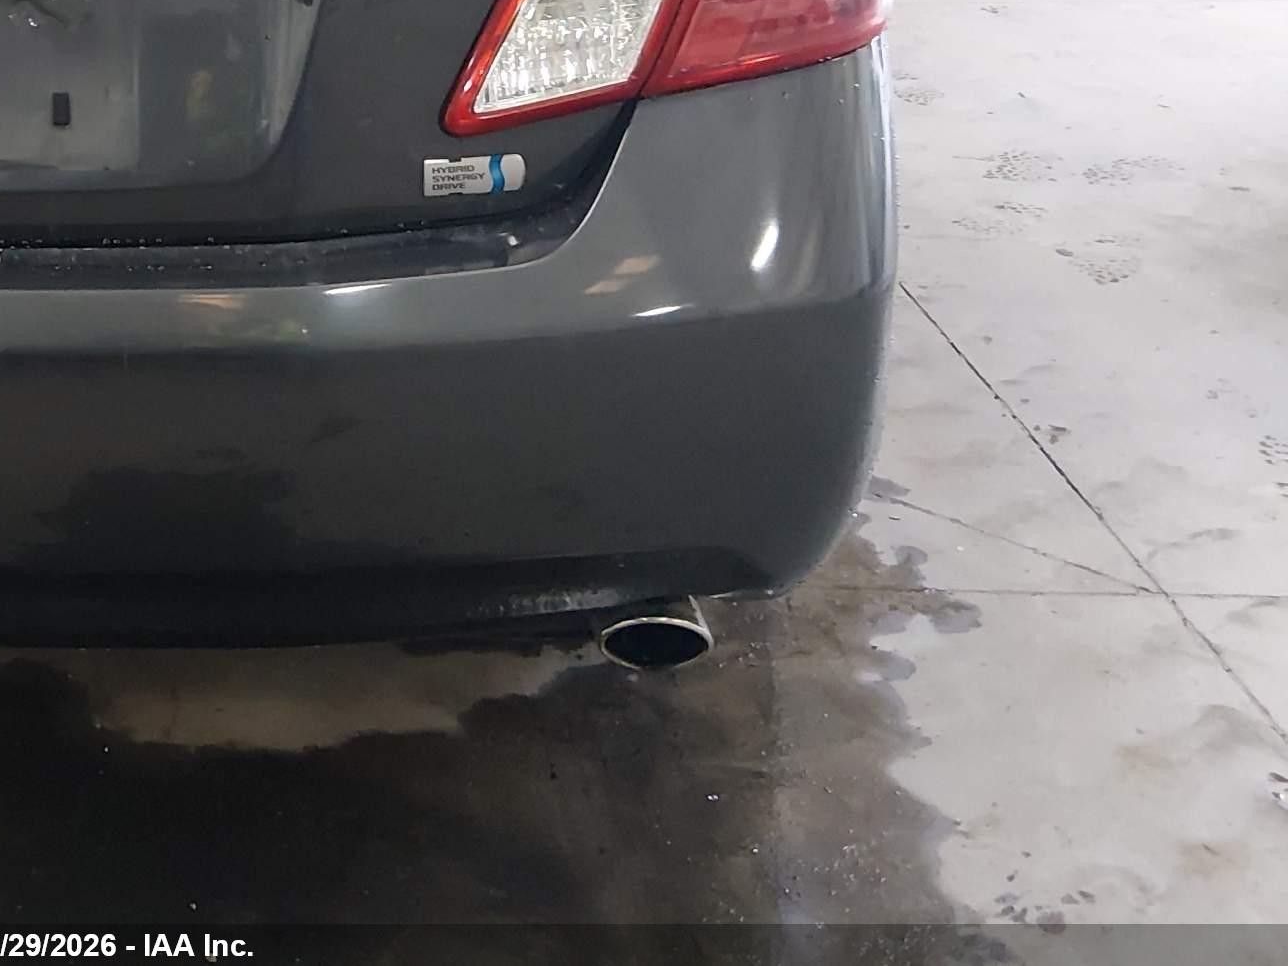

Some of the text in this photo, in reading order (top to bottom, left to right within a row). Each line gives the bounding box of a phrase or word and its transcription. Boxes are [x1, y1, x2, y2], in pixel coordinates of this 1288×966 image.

[432, 165, 475, 174] HYBRID
[432, 172, 486, 183] SYNERGY
[432, 183, 465, 191] DRIVE
